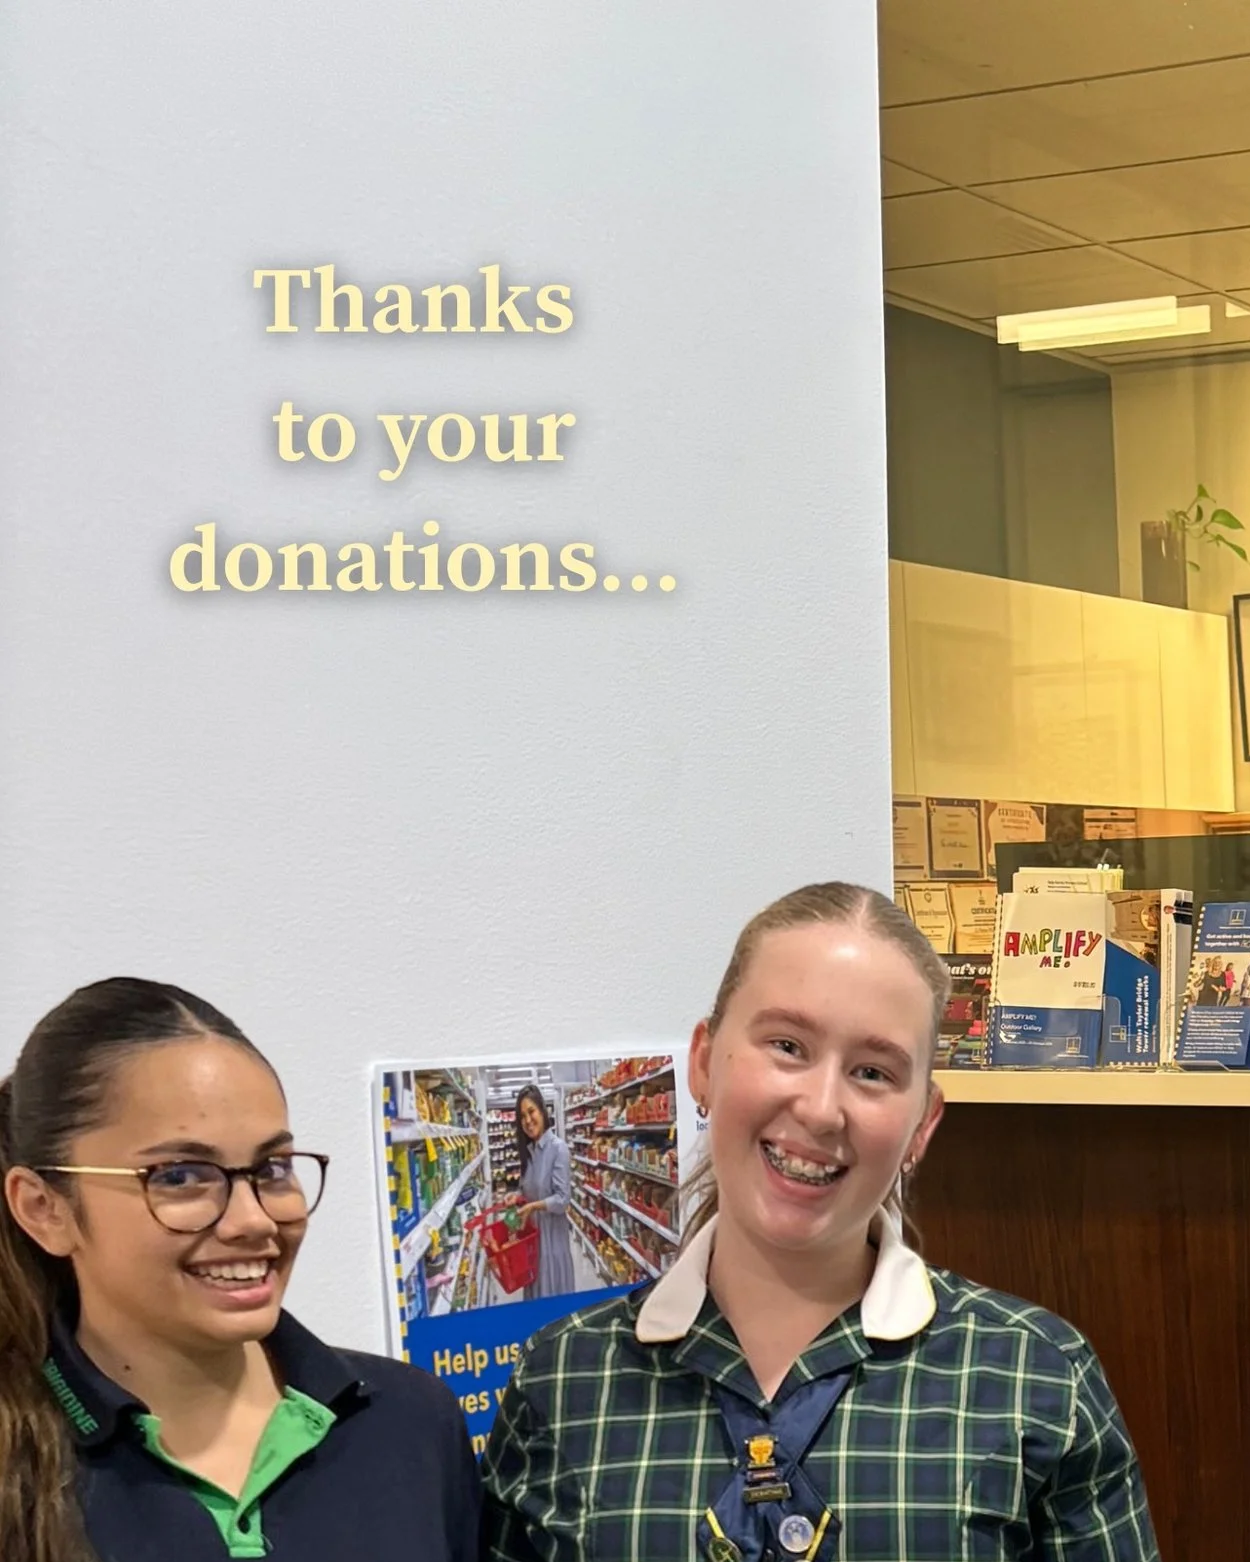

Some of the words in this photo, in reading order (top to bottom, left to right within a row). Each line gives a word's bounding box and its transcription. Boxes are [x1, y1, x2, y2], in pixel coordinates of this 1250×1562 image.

[1004, 928, 1102, 959] AMPLIFY
[945, 963, 977, 976] hat's
[1023, 1024, 1043, 1032] Gallery
[433, 1343, 488, 1378] Help
[494, 1342, 520, 1366] us
